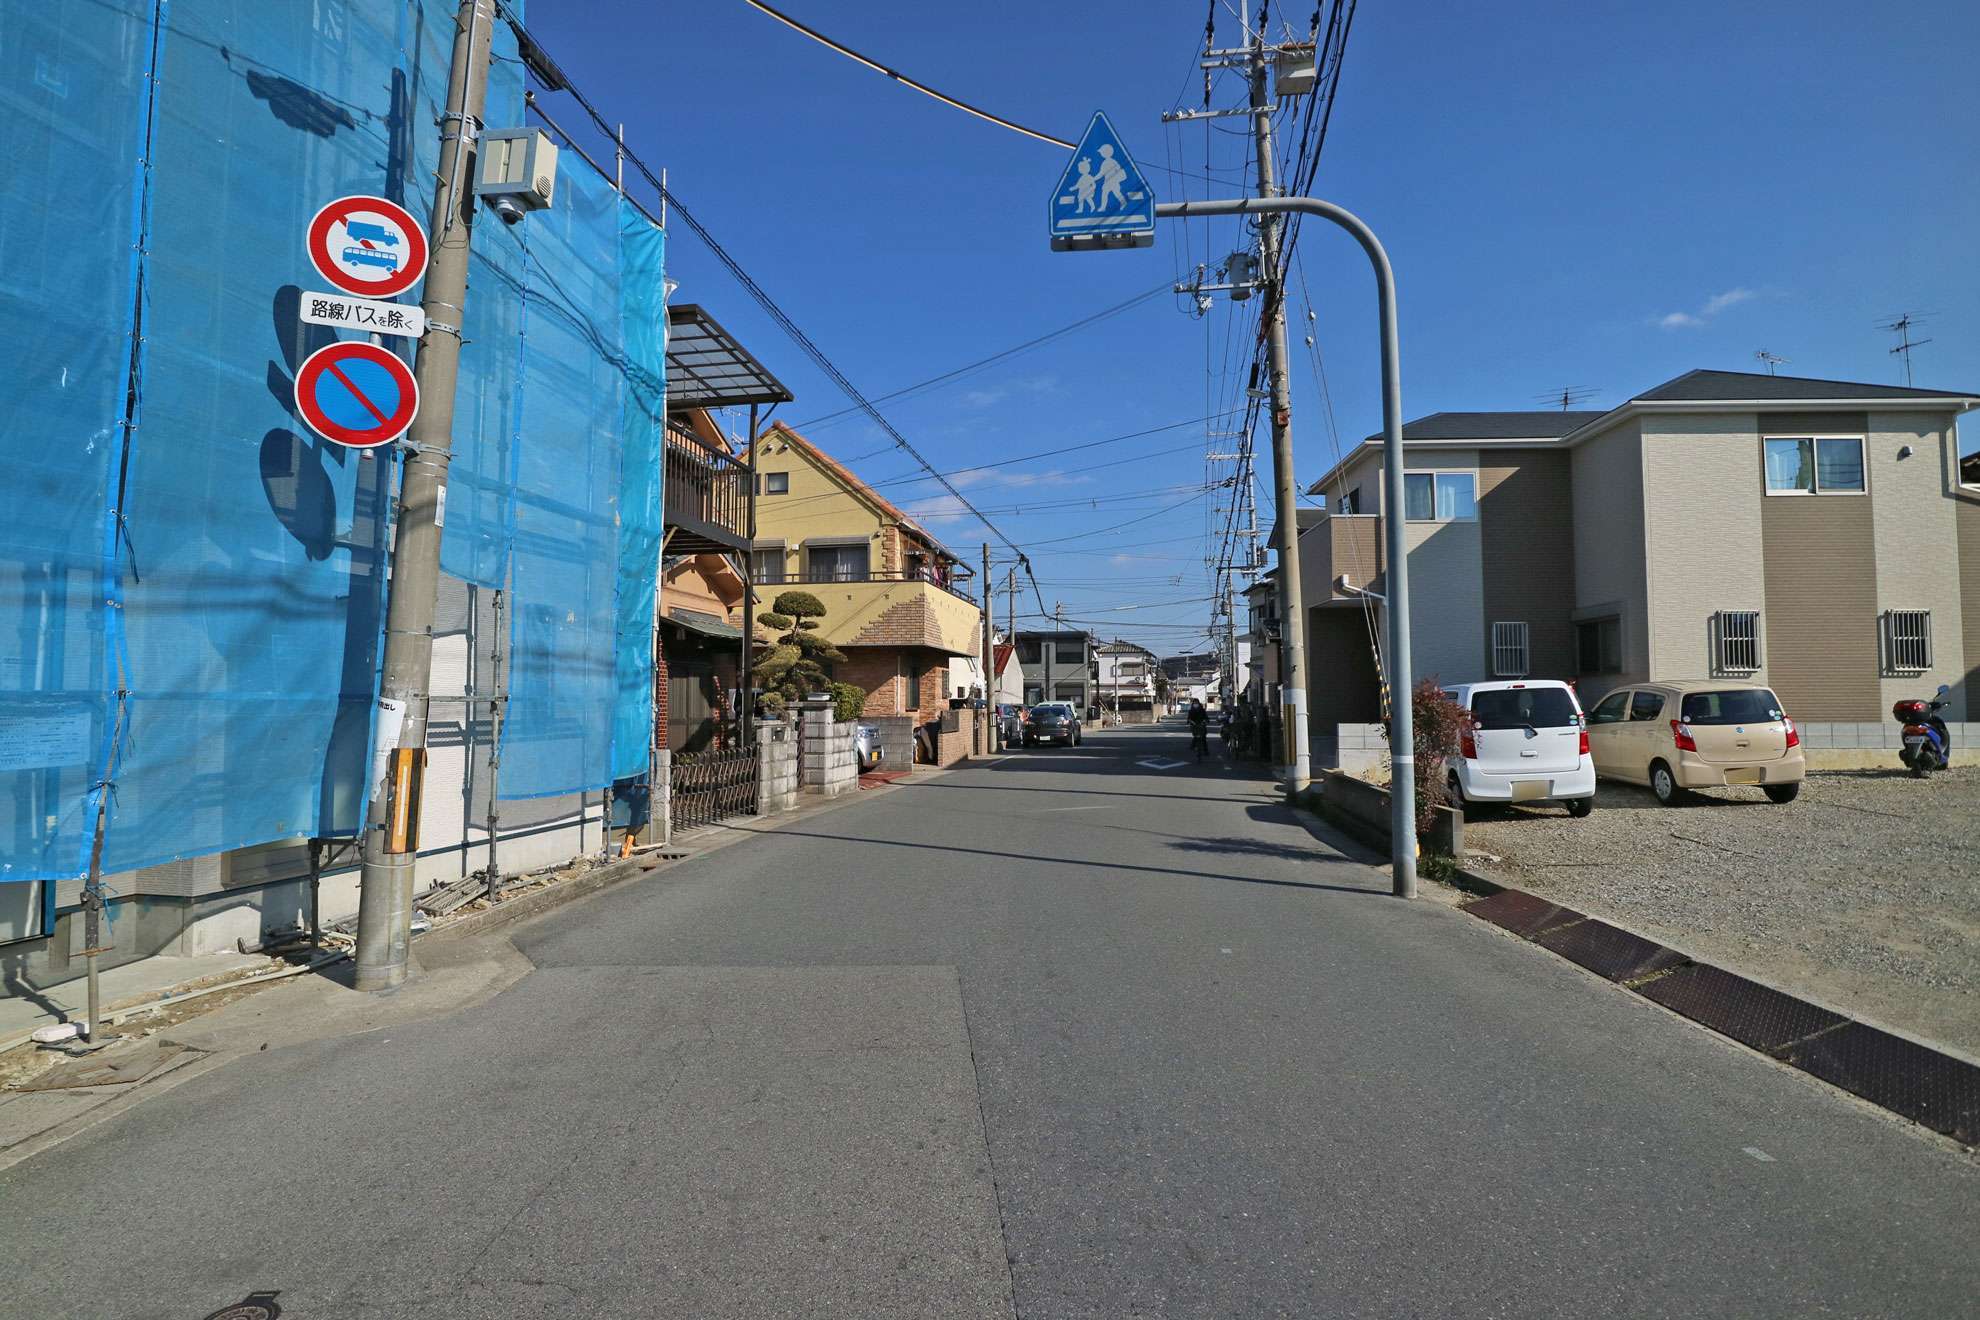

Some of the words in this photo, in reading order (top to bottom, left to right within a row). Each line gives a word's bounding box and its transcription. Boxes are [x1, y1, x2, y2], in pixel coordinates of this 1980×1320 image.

[311, 300, 413, 330] 路線バスを除く
